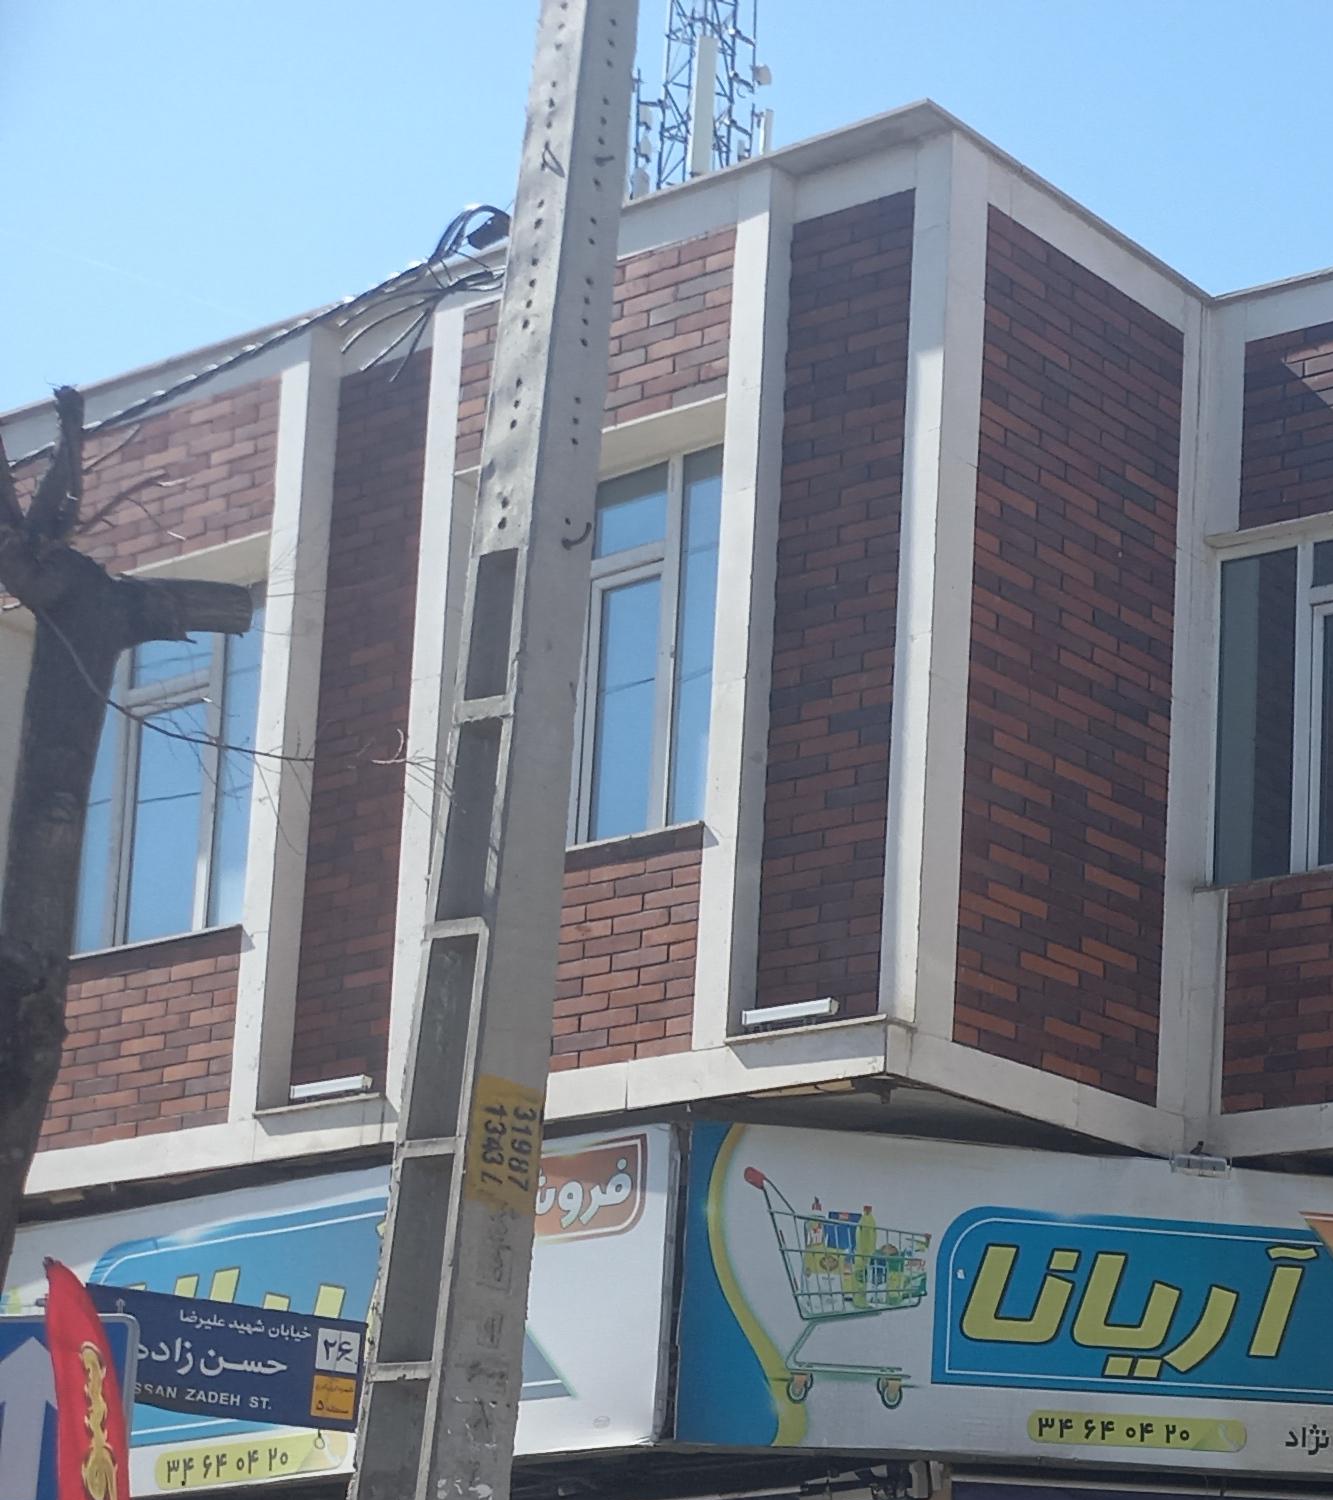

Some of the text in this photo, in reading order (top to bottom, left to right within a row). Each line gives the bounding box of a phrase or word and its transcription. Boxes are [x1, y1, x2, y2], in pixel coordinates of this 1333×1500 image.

[507, 1105, 537, 1192] 31987
[179, 1309, 312, 1342] خیابان شهید علیرضا
[960, 1243, 1319, 1379] آریانا
[200, 1348, 288, 1376] حسن
[185, 1388, 241, 1406] ZADEH
[249, 1396, 272, 1410] ST.
[1037, 1417, 1074, 1437] ۳۴
[1083, 1419, 1116, 1441] ۶۴
[1284, 1425, 1330, 1455] نژاد
